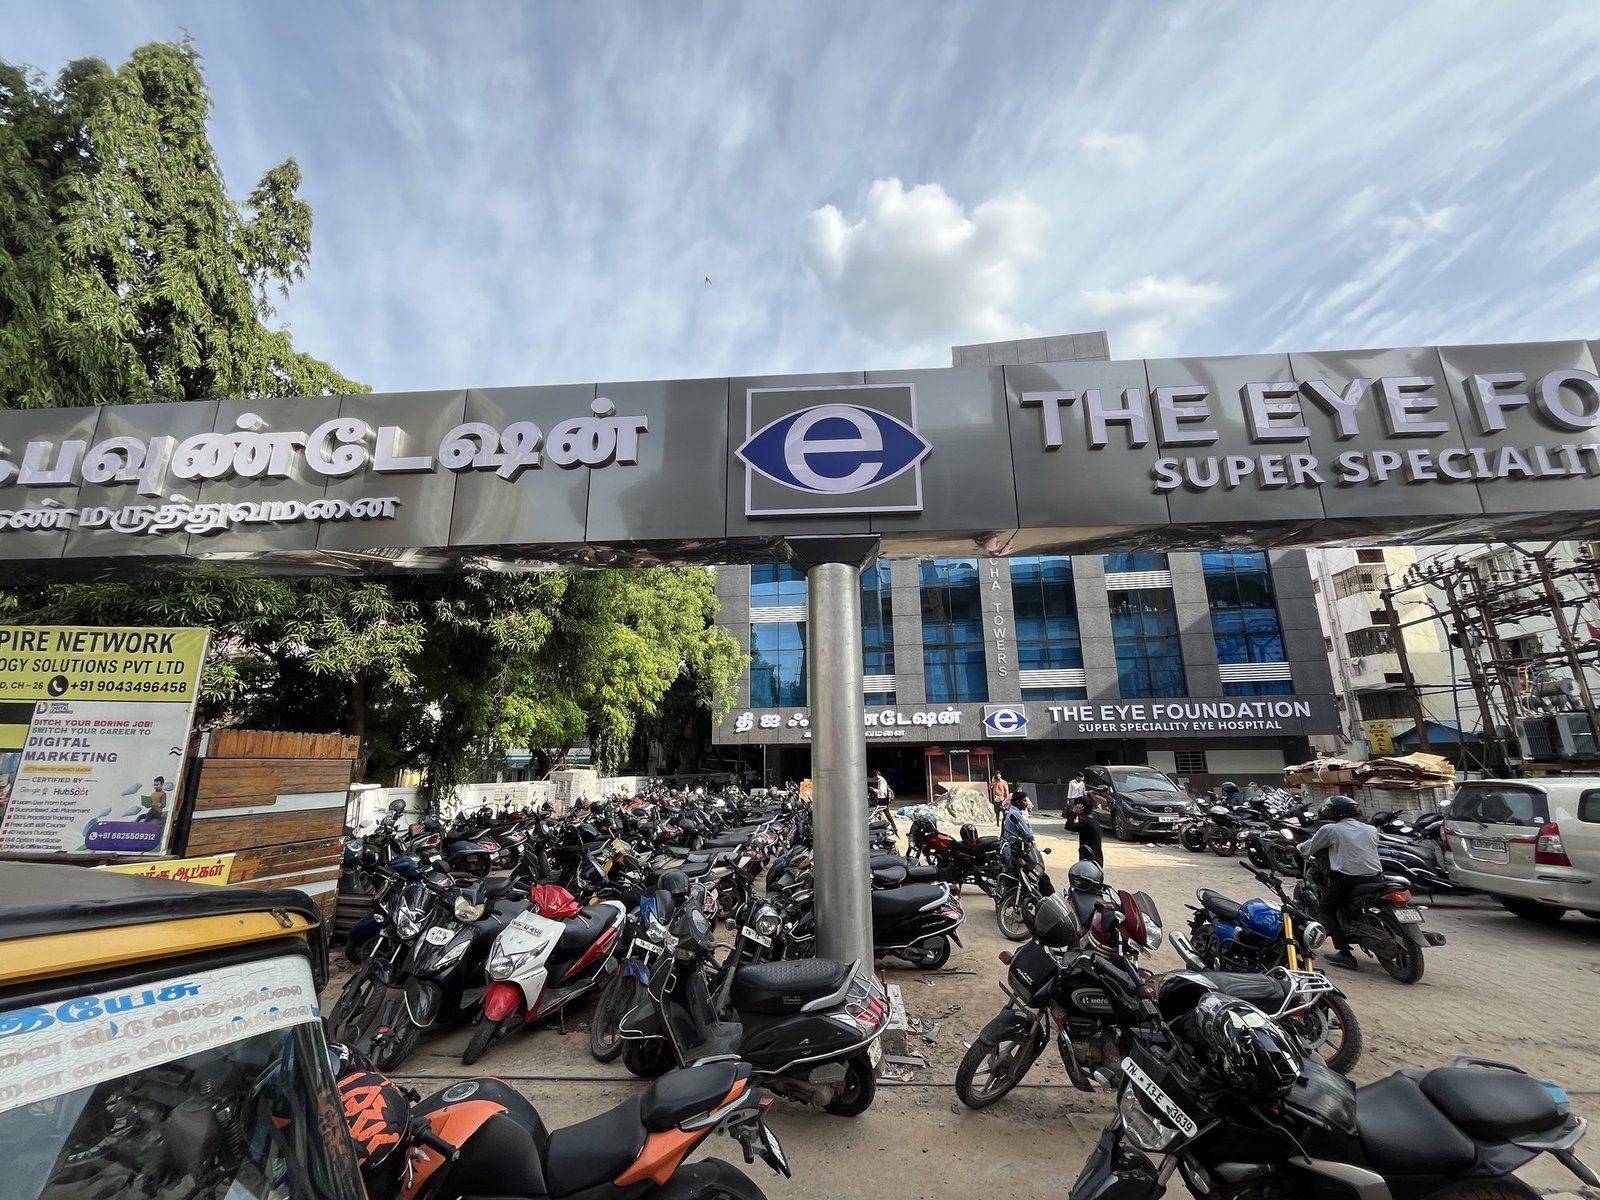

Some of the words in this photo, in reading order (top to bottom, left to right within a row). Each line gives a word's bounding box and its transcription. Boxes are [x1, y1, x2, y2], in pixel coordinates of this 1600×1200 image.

[1019, 384, 1218, 452] THE
[1239, 376, 1450, 444] EYE
[784, 406, 884, 492] e
[1152, 454, 1326, 493] SUPER
[78, 493, 400, 535] மருத்துவமனை
[56, 632, 176, 654] NETWORK
[993, 602, 1008, 677] TOWERS
[32, 658, 118, 673] SOLUTIONS
[122, 660, 153, 674] PVT
[156, 660, 185, 675] LTD
[11, 682, 24, 690] CH
[32, 682, 43, 690] 26
[70, 681, 94, 692] +91
[97, 681, 187, 693] 9043496458
[1049, 706, 1094, 722] THE
[1101, 704, 1146, 721] EYE
[1152, 701, 1311, 720] FOUNDATION
[33, 719, 61, 727] DITCH
[94, 720, 130, 728] BORING
[1078, 723, 1117, 733] SUPER
[1120, 722, 1189, 733] SPECIALITY
[1193, 721, 1215, 731] EYE
[1218, 720, 1282, 731] HOSPITAL
[99, 728, 136, 736] CAREER
[28, 737, 91, 748] DIGITAL
[24, 751, 118, 763] MARKETING
[53, 787, 89, 797] HubSpot
[111, 832, 156, 841] 8825509312
[1169, 1109, 1194, 1133] 3639
